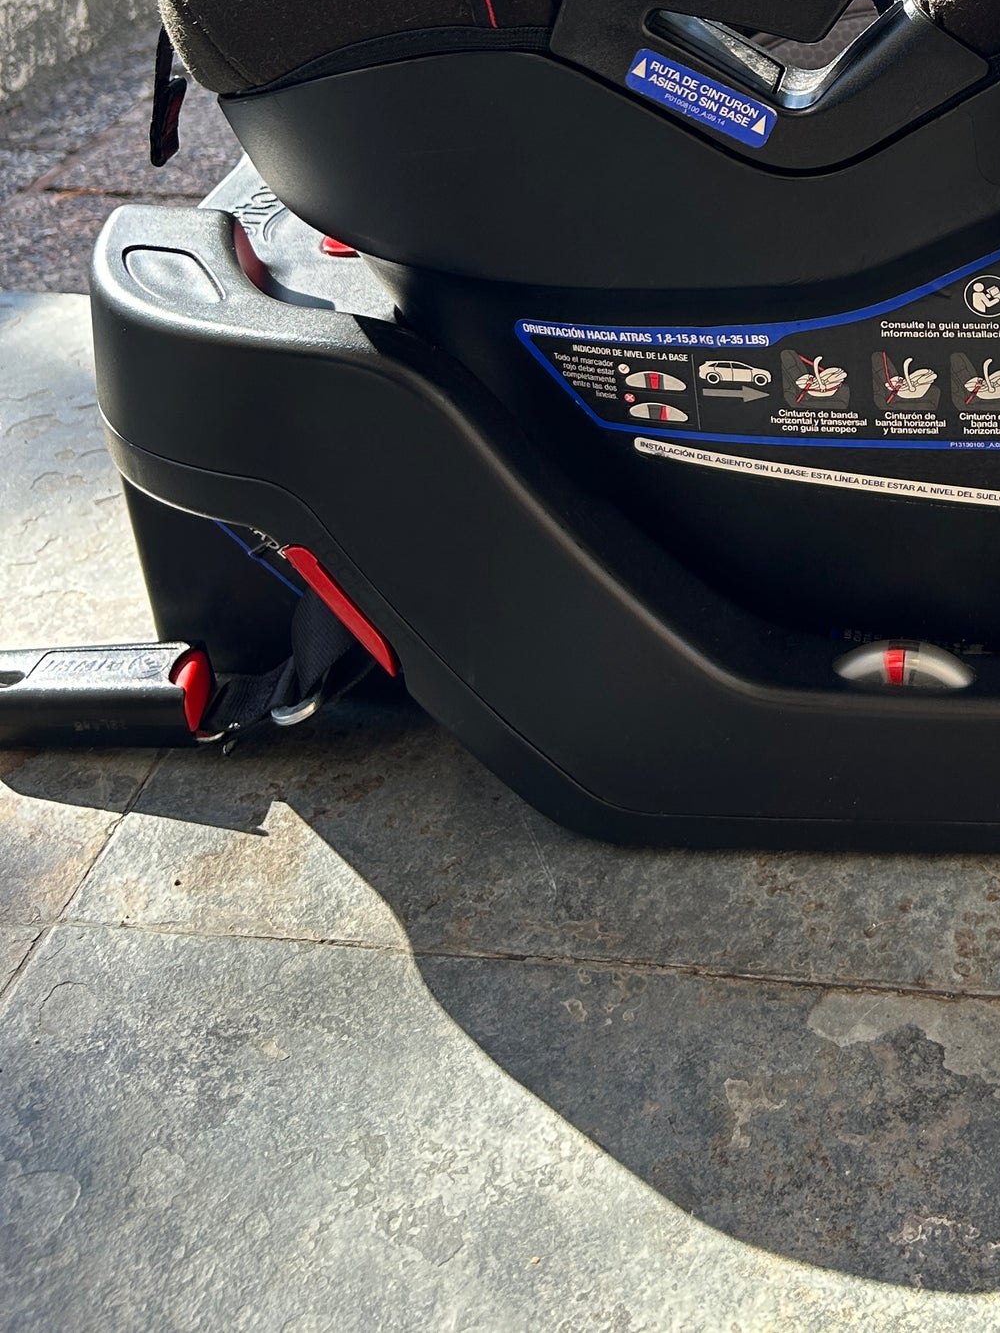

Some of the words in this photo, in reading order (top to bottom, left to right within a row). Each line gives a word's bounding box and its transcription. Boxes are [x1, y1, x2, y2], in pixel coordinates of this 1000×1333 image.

[650, 61, 679, 81] RUTA
[681, 76, 698, 89] DE
[700, 85, 758, 117] CINTURÓN
[649, 75, 697, 100] ASIENTO
[698, 96, 718, 111] SIN
[719, 106, 750, 126] BASE
[880, 320, 924, 332] Consulte
[927, 321, 935, 332] la
[962, 322, 998, 332] usuario
[522, 323, 584, 337] ORIENTACIÓN
[586, 330, 617, 340] HACIA
[619, 332, 651, 342] ATRAS
[656, 333, 697, 344] 1,8-15,8
[698, 335, 713, 344] KG
[716, 334, 743, 345] (4-35
[745, 334, 768, 346] LBS)
[572, 344, 610, 354] INDICADOR
[612, 348, 622, 356] DE
[623, 350, 644, 358] NIVEL
[645, 351, 656, 359] DE
[657, 352, 667, 360] LA
[668, 353, 687, 361] BASE
[778, 409, 815, 419] Cinturón
[817, 410, 828, 419] de
[884, 411, 922, 421] Cinturón
[959, 412, 996, 422] Cinturón
[770, 416, 812, 426] horizontal
[820, 417, 866, 425] transversal
[875, 419, 902, 428] banda
[904, 419, 945, 428] horizontal
[970, 420, 997, 429] banda
[883, 427, 888, 435] y
[890, 426, 938, 434] transversal
[696, 453, 712, 461] DEL
[714, 457, 752, 468] ASIENTO
[754, 463, 768, 471] SIN
[810, 471, 832, 480] ESTA
[834, 474, 859, 483] LÍNEA
[861, 478, 884, 487] DEBE
[887, 482, 914, 490] ESTAR
[930, 487, 954, 495] NIVEL
[957, 490, 973, 498] DEL
